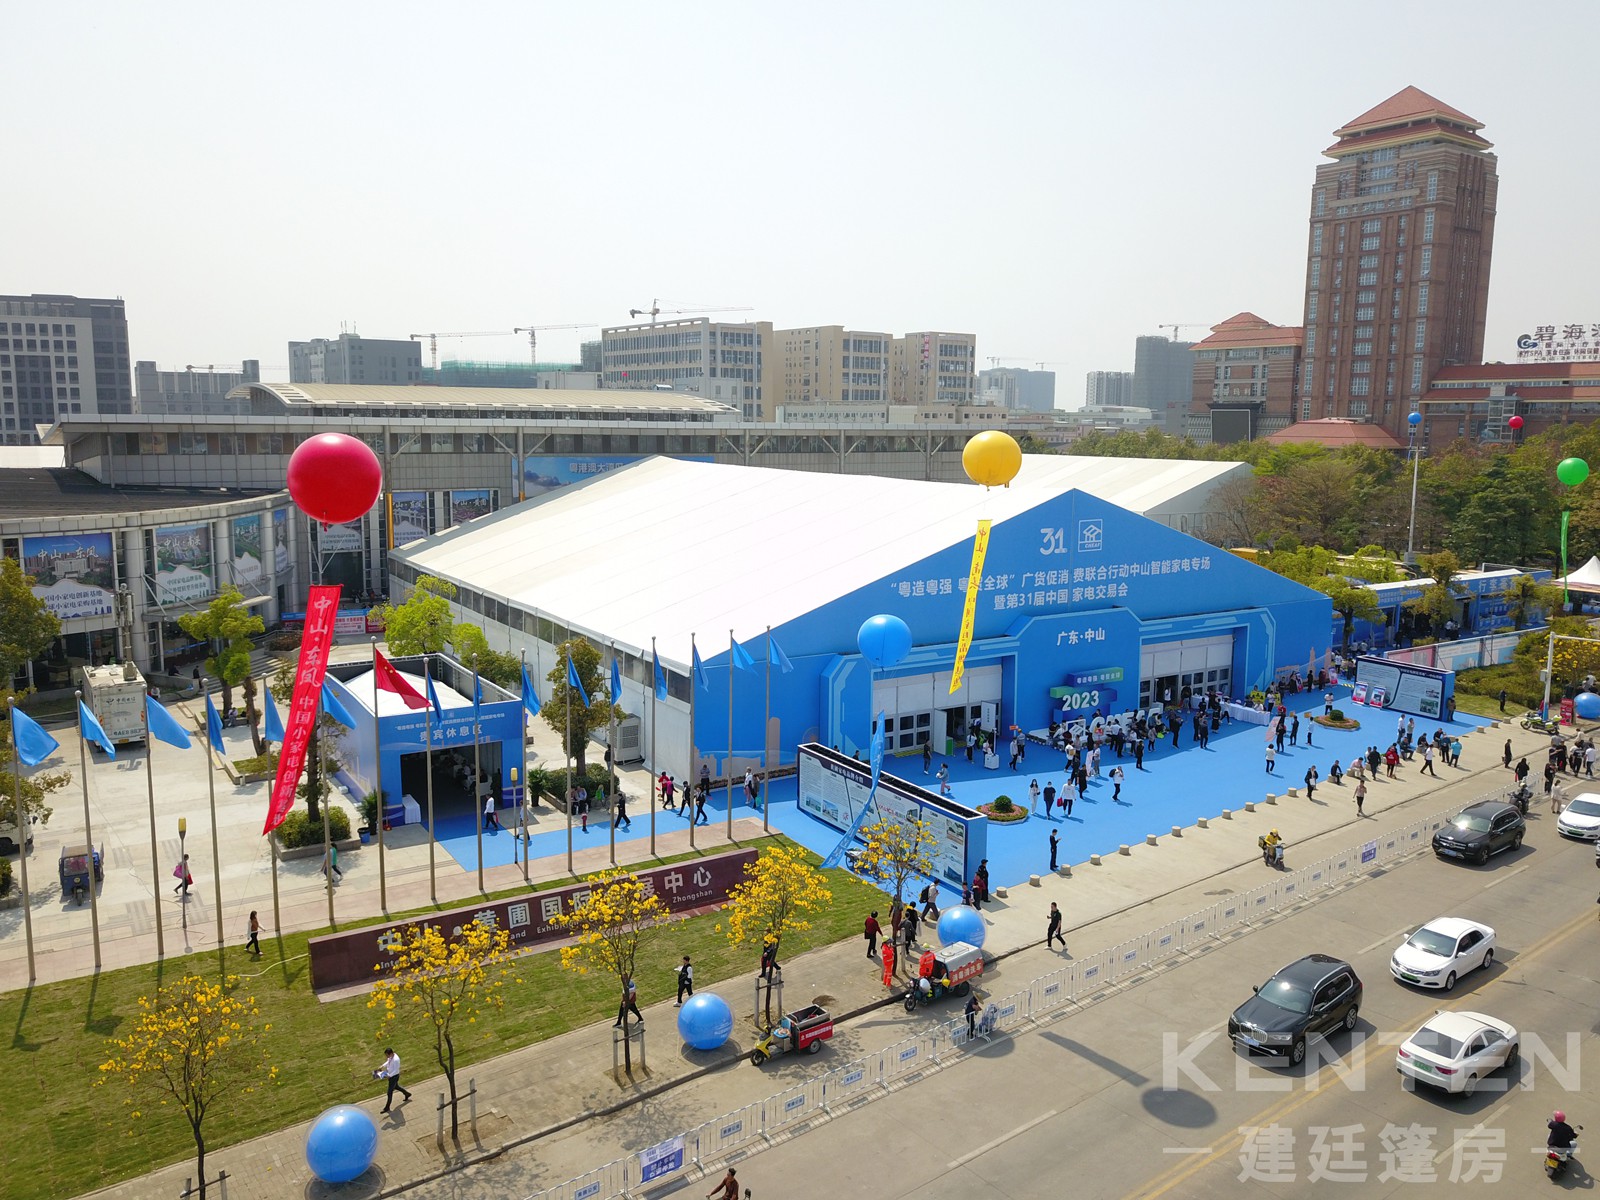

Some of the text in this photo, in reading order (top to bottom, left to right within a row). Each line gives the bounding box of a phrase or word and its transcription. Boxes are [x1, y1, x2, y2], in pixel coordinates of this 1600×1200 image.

[1040, 527, 1067, 555] 31
[1056, 627, 1106, 647] 广东·中山
[1061, 690, 1100, 711] 2023
[672, 888, 713, 903] Zhongshan
